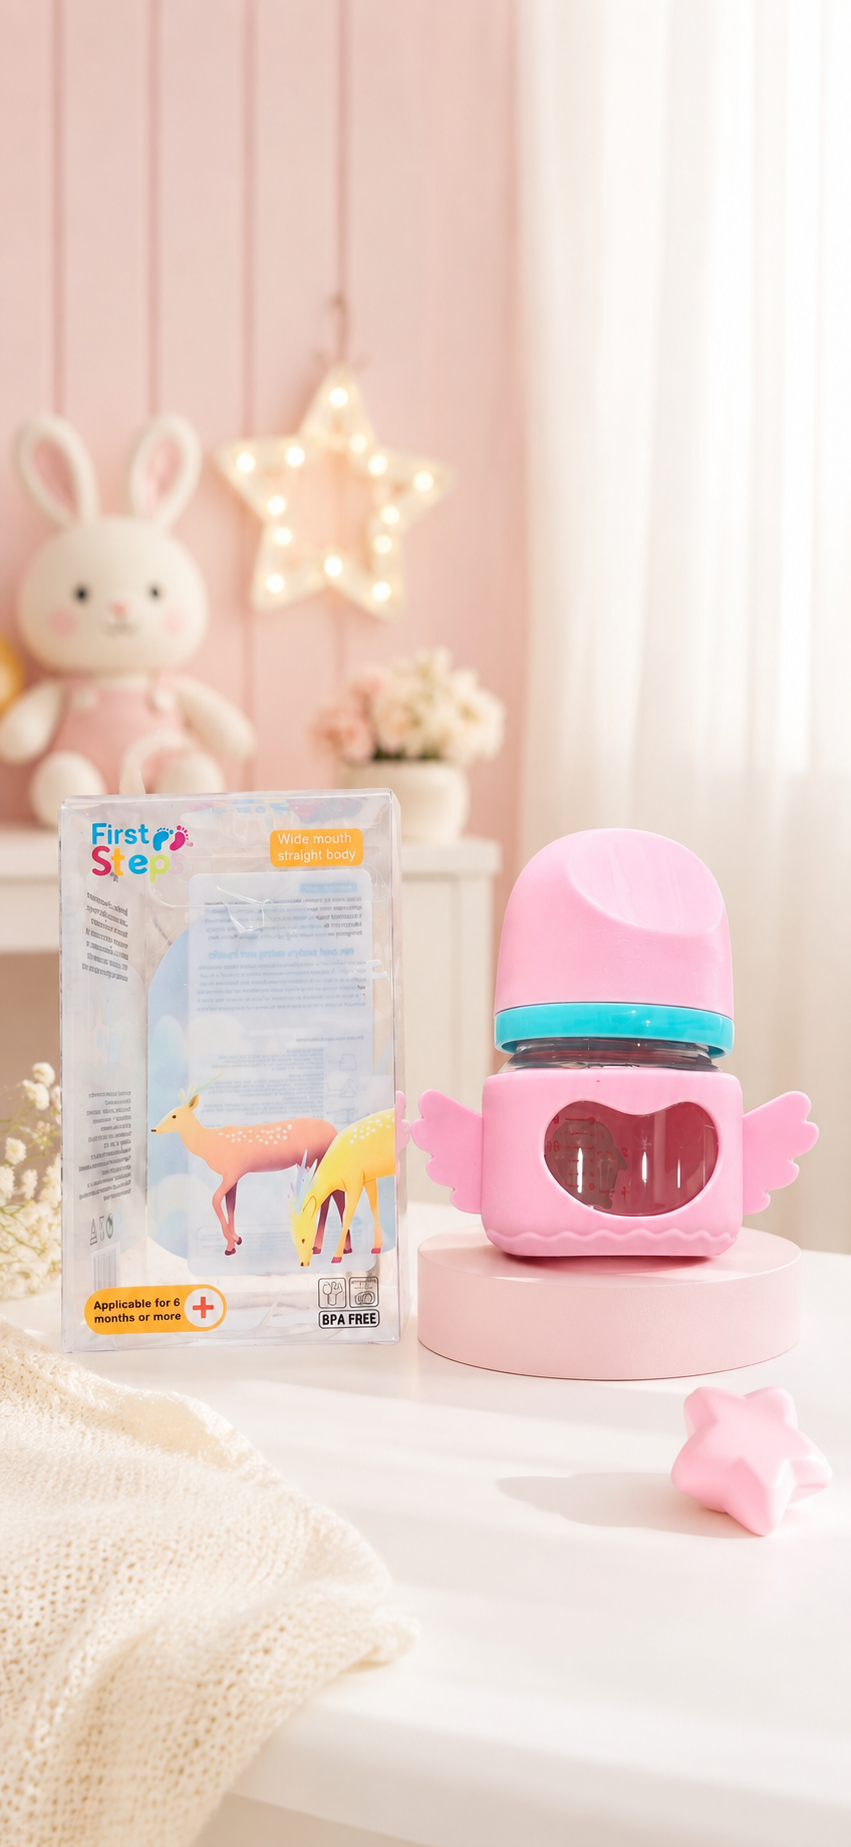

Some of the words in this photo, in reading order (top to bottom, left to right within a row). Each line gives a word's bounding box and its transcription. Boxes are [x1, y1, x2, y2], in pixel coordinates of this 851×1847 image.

[92, 823, 149, 845] First
[277, 832, 309, 845] Wide
[313, 831, 352, 844] mouth
[278, 849, 322, 863] straight
[326, 848, 356, 862] body
[93, 1299, 152, 1311] Applicable
[154, 1298, 171, 1308] for
[173, 1298, 181, 1307] 6
[94, 1313, 135, 1324] months
[138, 1314, 150, 1322] or
[153, 1313, 181, 1321] more
[322, 1313, 345, 1326] BPA
[348, 1312, 377, 1325] FREE
